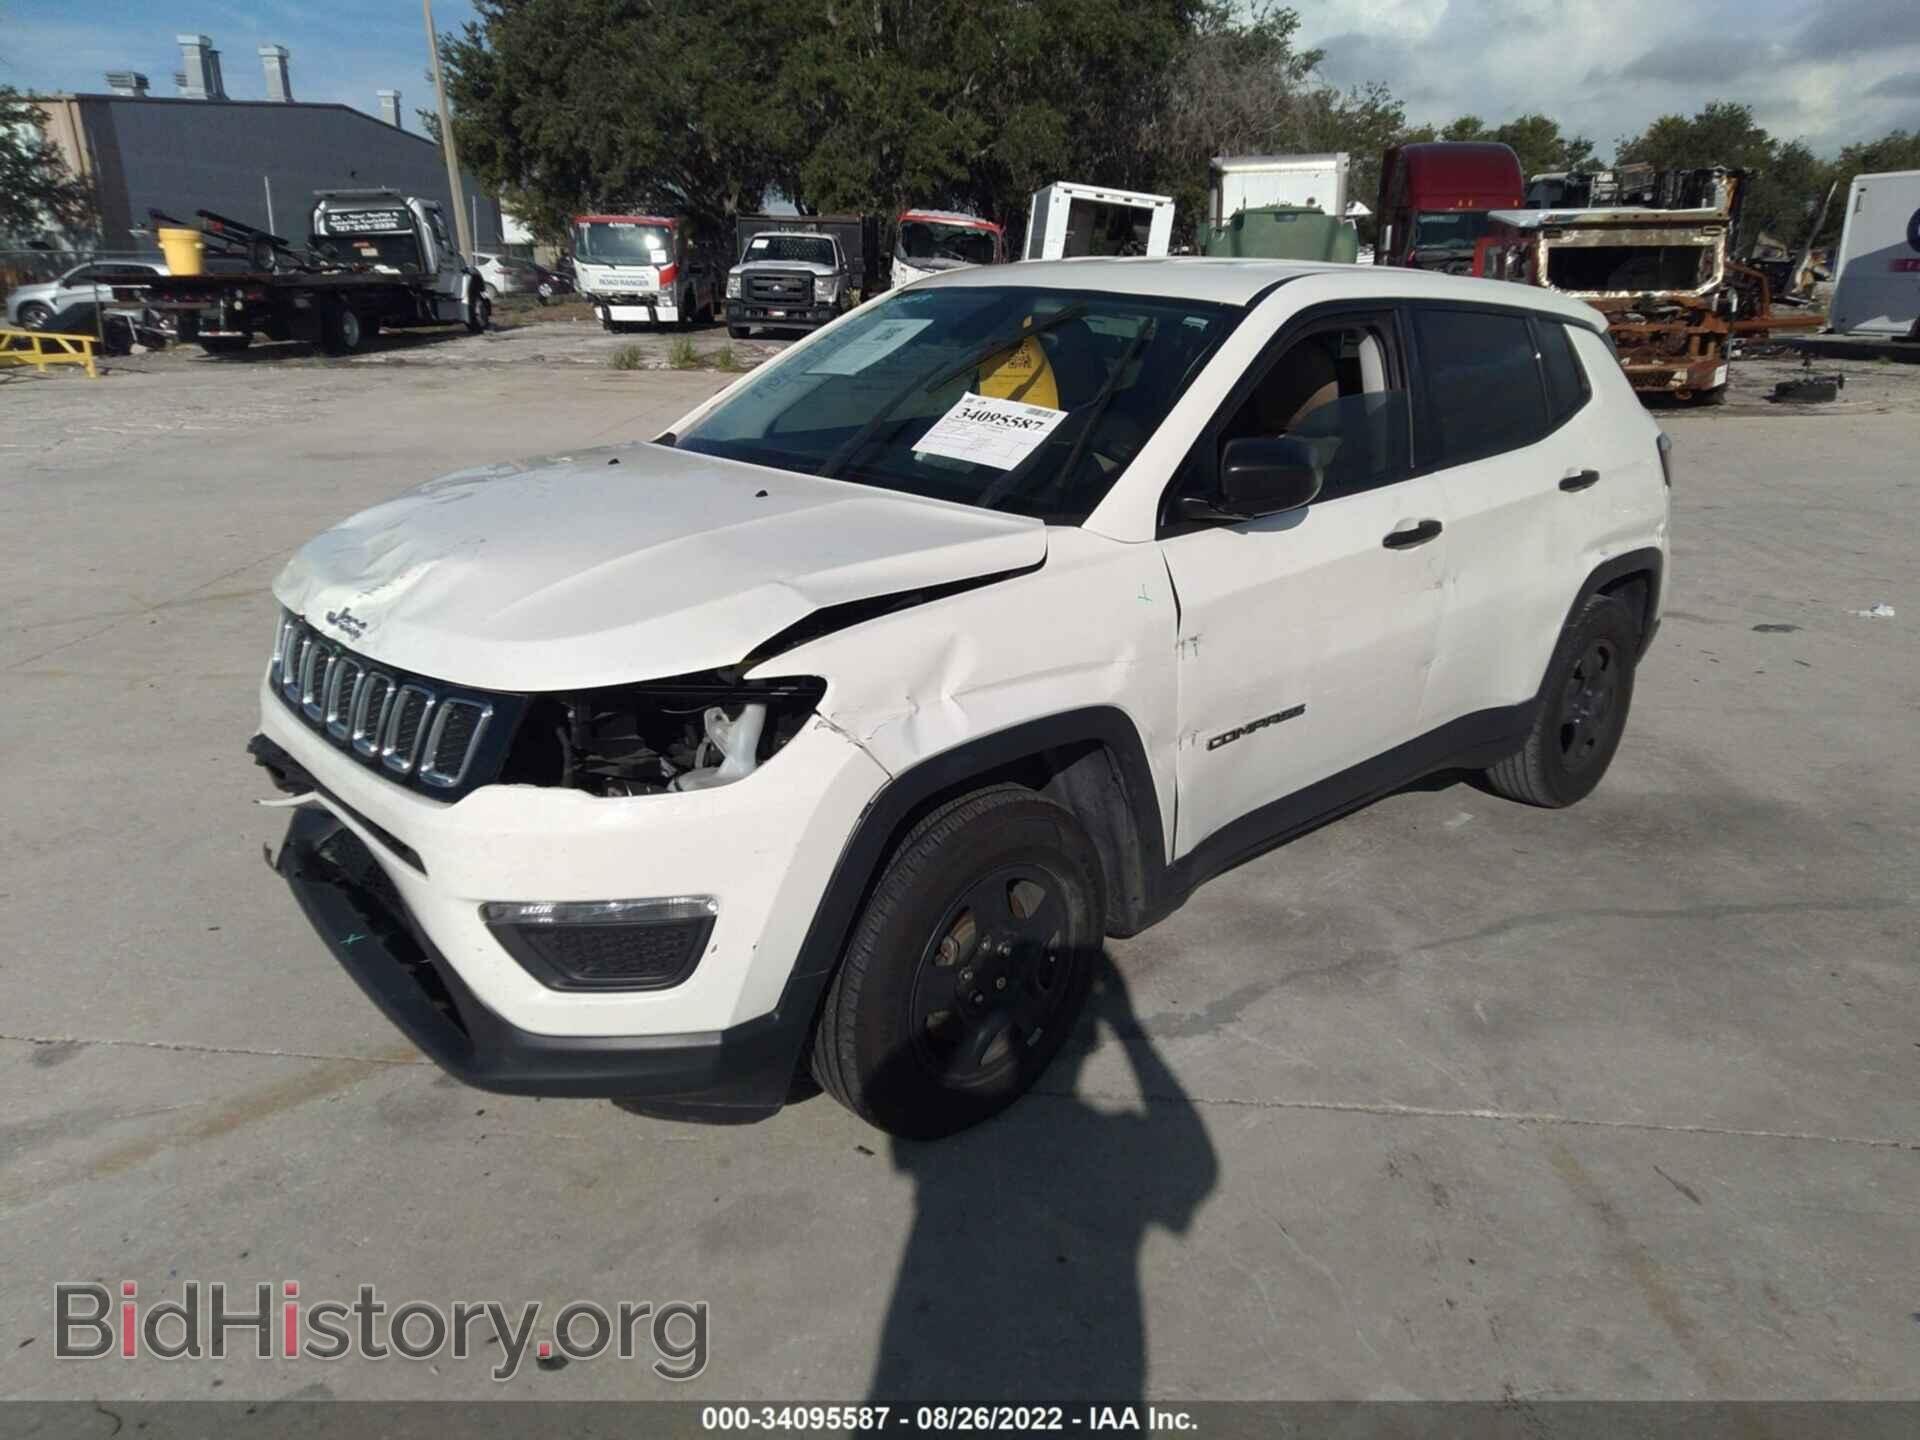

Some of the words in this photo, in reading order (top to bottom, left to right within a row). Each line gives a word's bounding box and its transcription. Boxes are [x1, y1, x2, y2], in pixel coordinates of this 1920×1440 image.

[620, 279, 649, 287] RANGER
[955, 407, 1045, 431] 34095587
[1207, 704, 1306, 751] COMPASS
